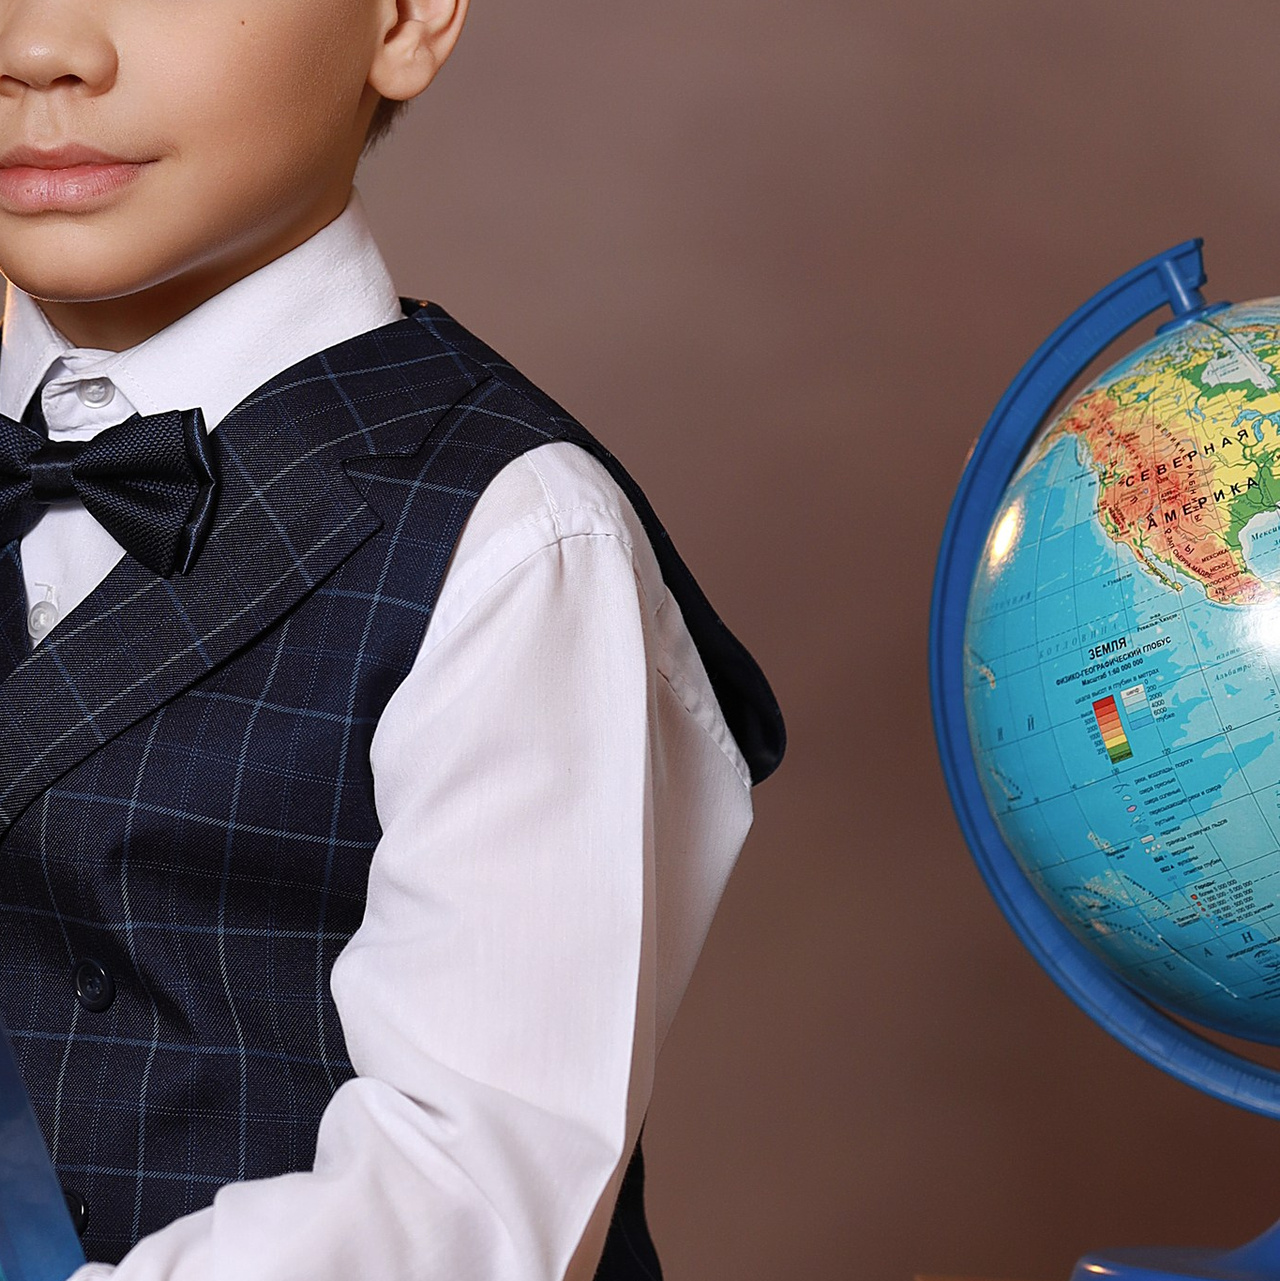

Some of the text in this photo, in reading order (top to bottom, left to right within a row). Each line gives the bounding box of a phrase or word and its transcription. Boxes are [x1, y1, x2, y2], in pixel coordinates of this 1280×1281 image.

[1125, 429, 1249, 488] СЕВЕРНАЯ
[1147, 477, 1259, 531] АМЕРИКА
[1055, 636, 1172, 686] ФИЗИКО-ГЕОГРАФИЧЕСКИЙ ГЛОБУС
[1088, 637, 1127, 660] ЗЕМЛЯ
[1081, 673, 1108, 686] Масштаб
